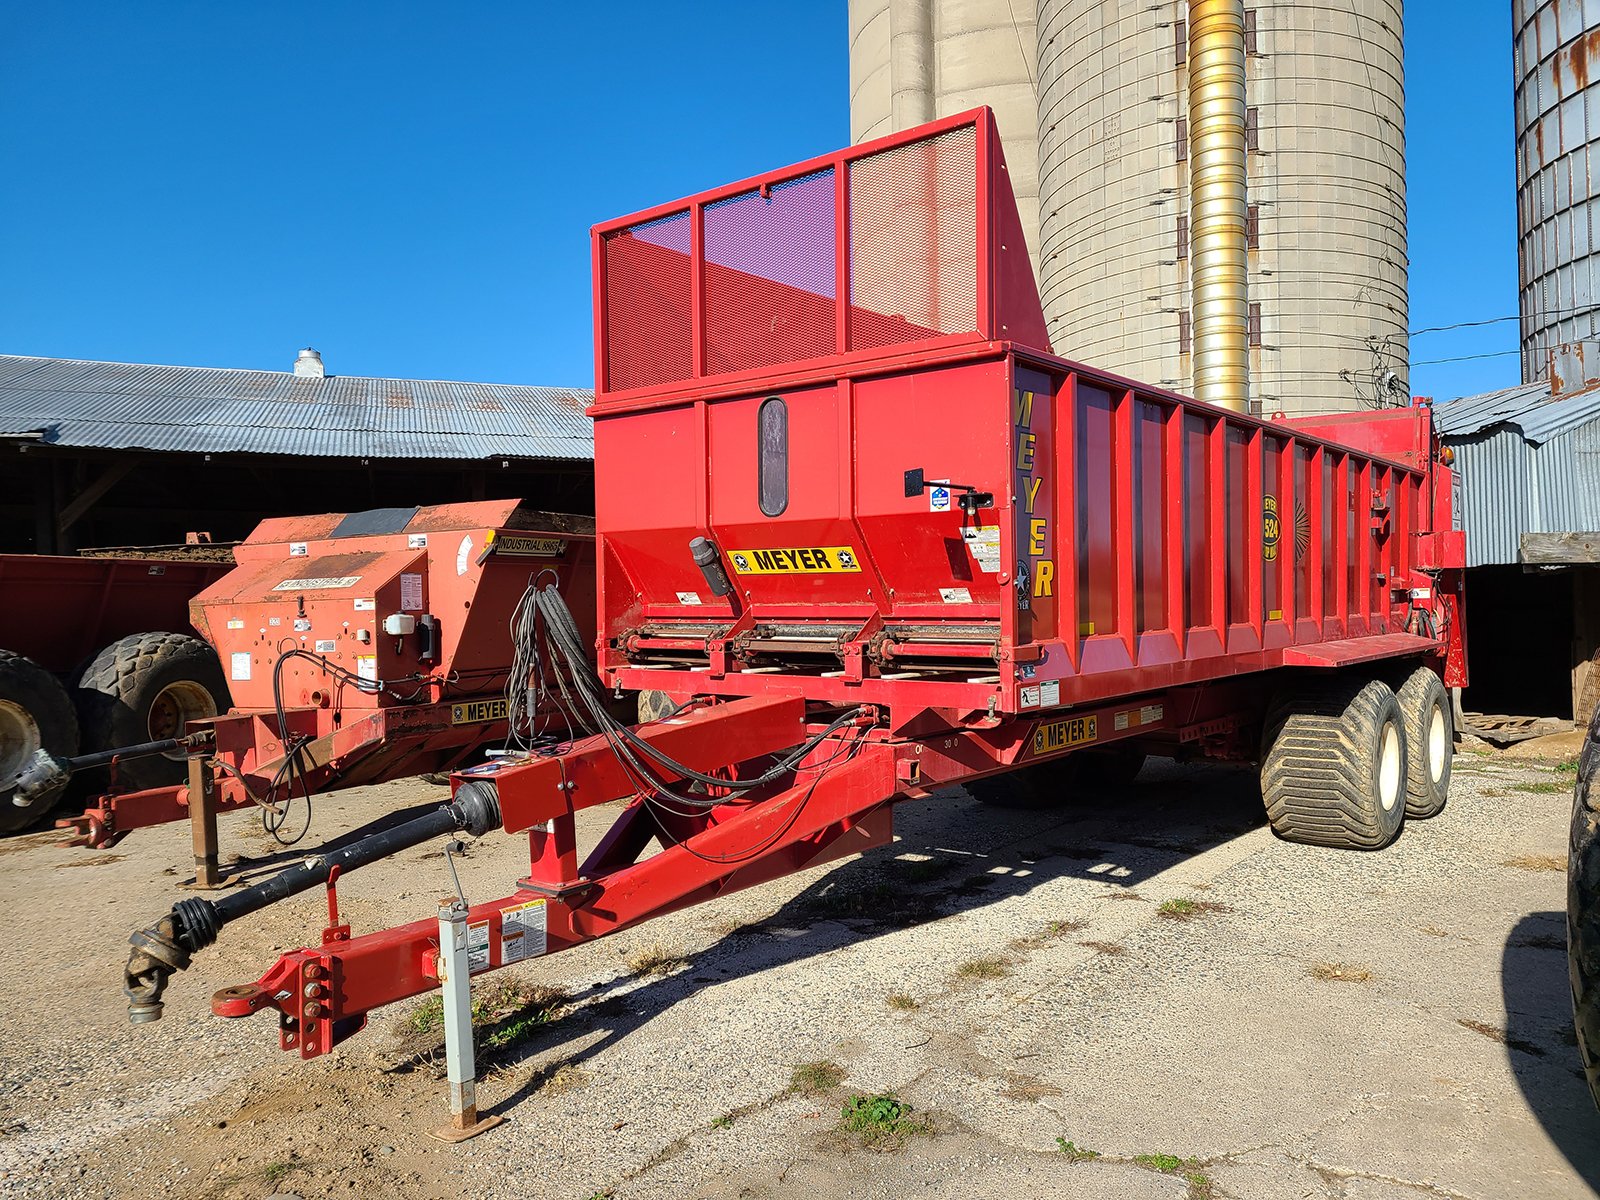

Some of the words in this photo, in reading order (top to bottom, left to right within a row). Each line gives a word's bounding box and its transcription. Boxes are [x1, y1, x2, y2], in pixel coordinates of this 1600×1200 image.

[1264, 518, 1279, 538] 524
[500, 538, 541, 551] INDUSTRIAL
[752, 549, 832, 570] MEYER
[467, 701, 507, 720] MEYER
[1047, 719, 1085, 747] MEYER
